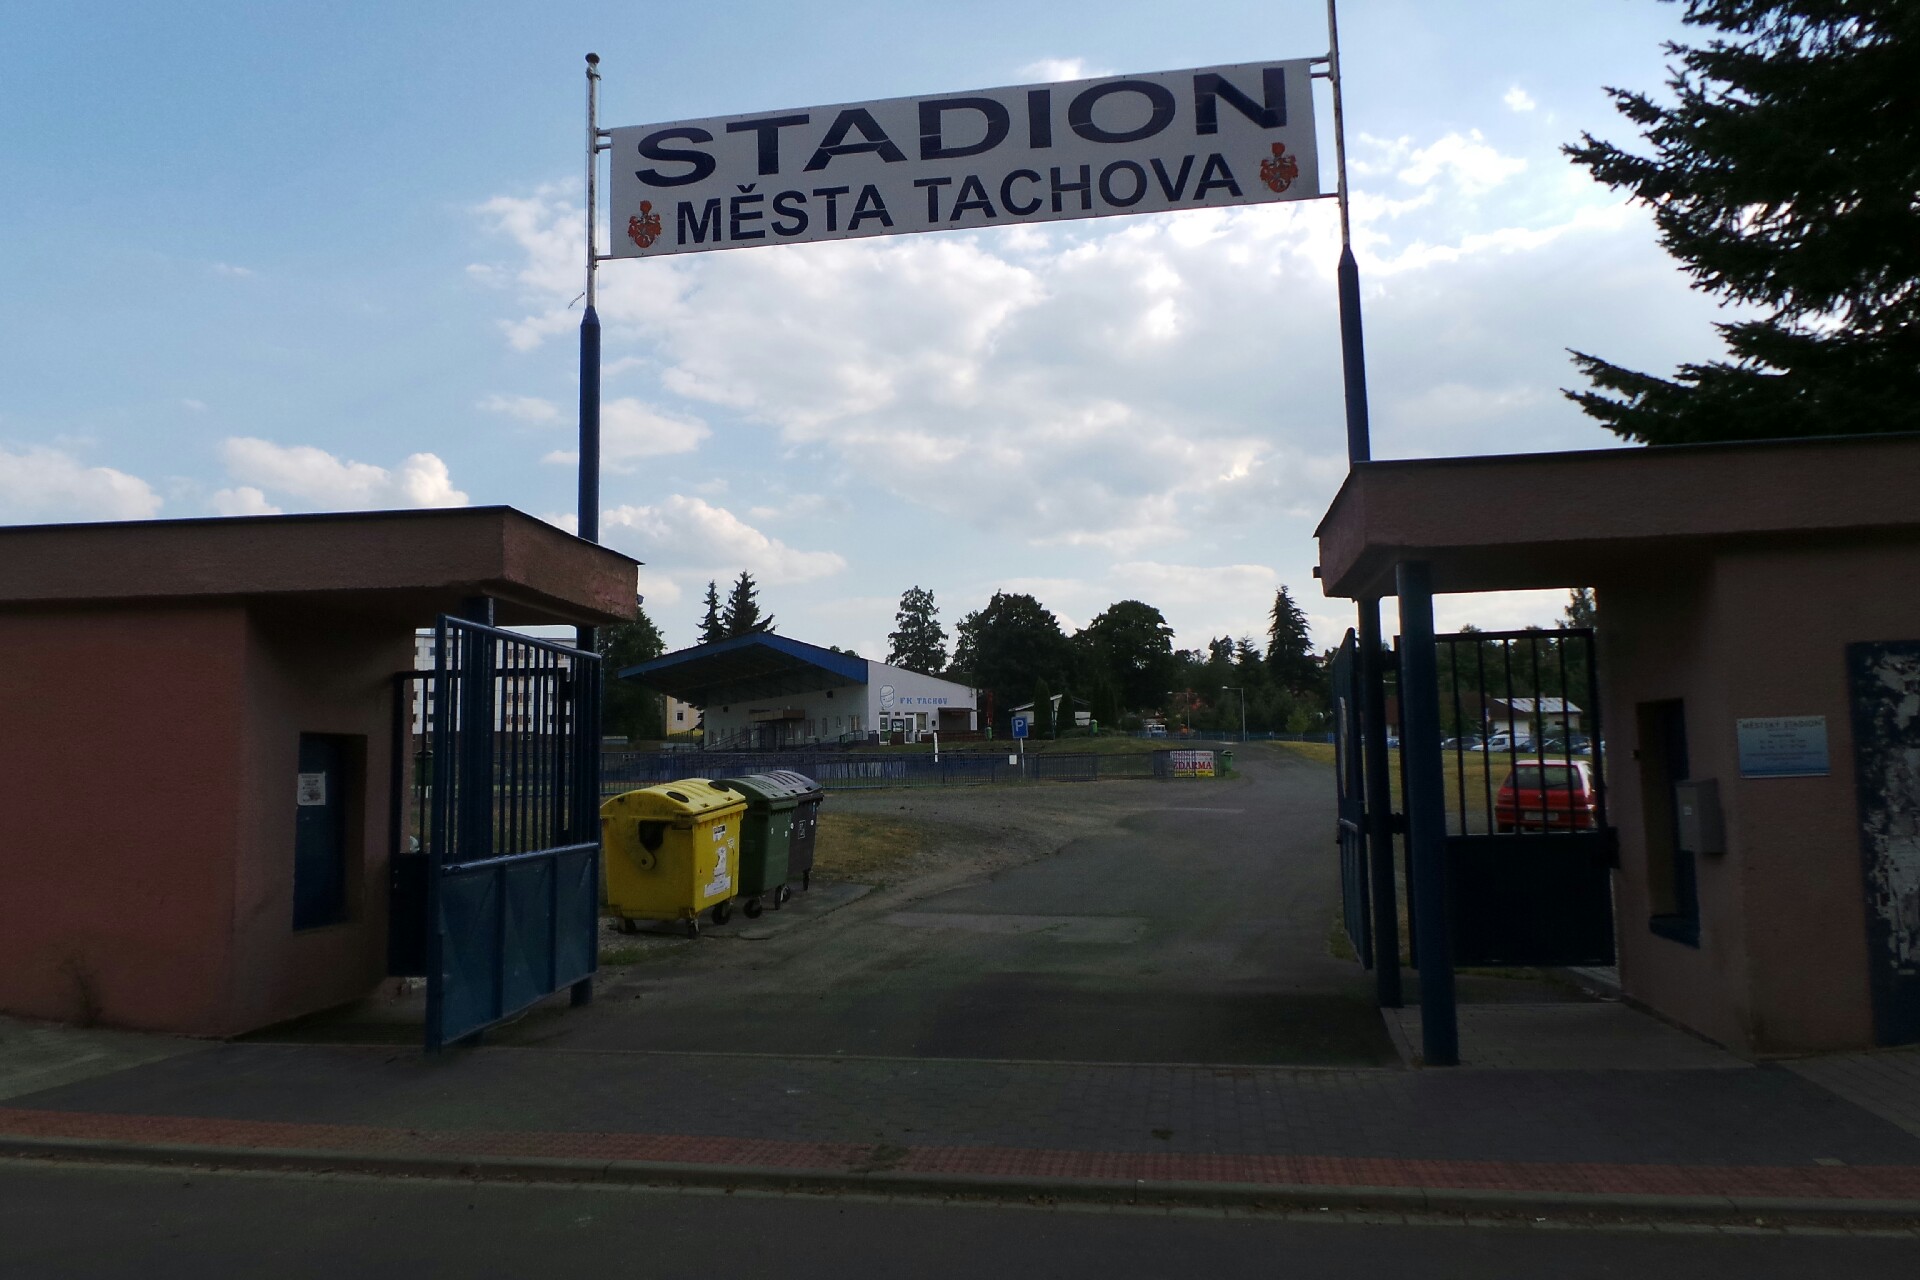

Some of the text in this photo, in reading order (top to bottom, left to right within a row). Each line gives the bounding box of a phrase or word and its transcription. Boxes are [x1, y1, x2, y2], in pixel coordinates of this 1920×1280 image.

[634, 67, 1288, 188] STADION
[676, 152, 1244, 246] MĚSTA TACHOVA
[1015, 719, 1024, 732] P
[1173, 761, 1213, 770] ZDARMA
